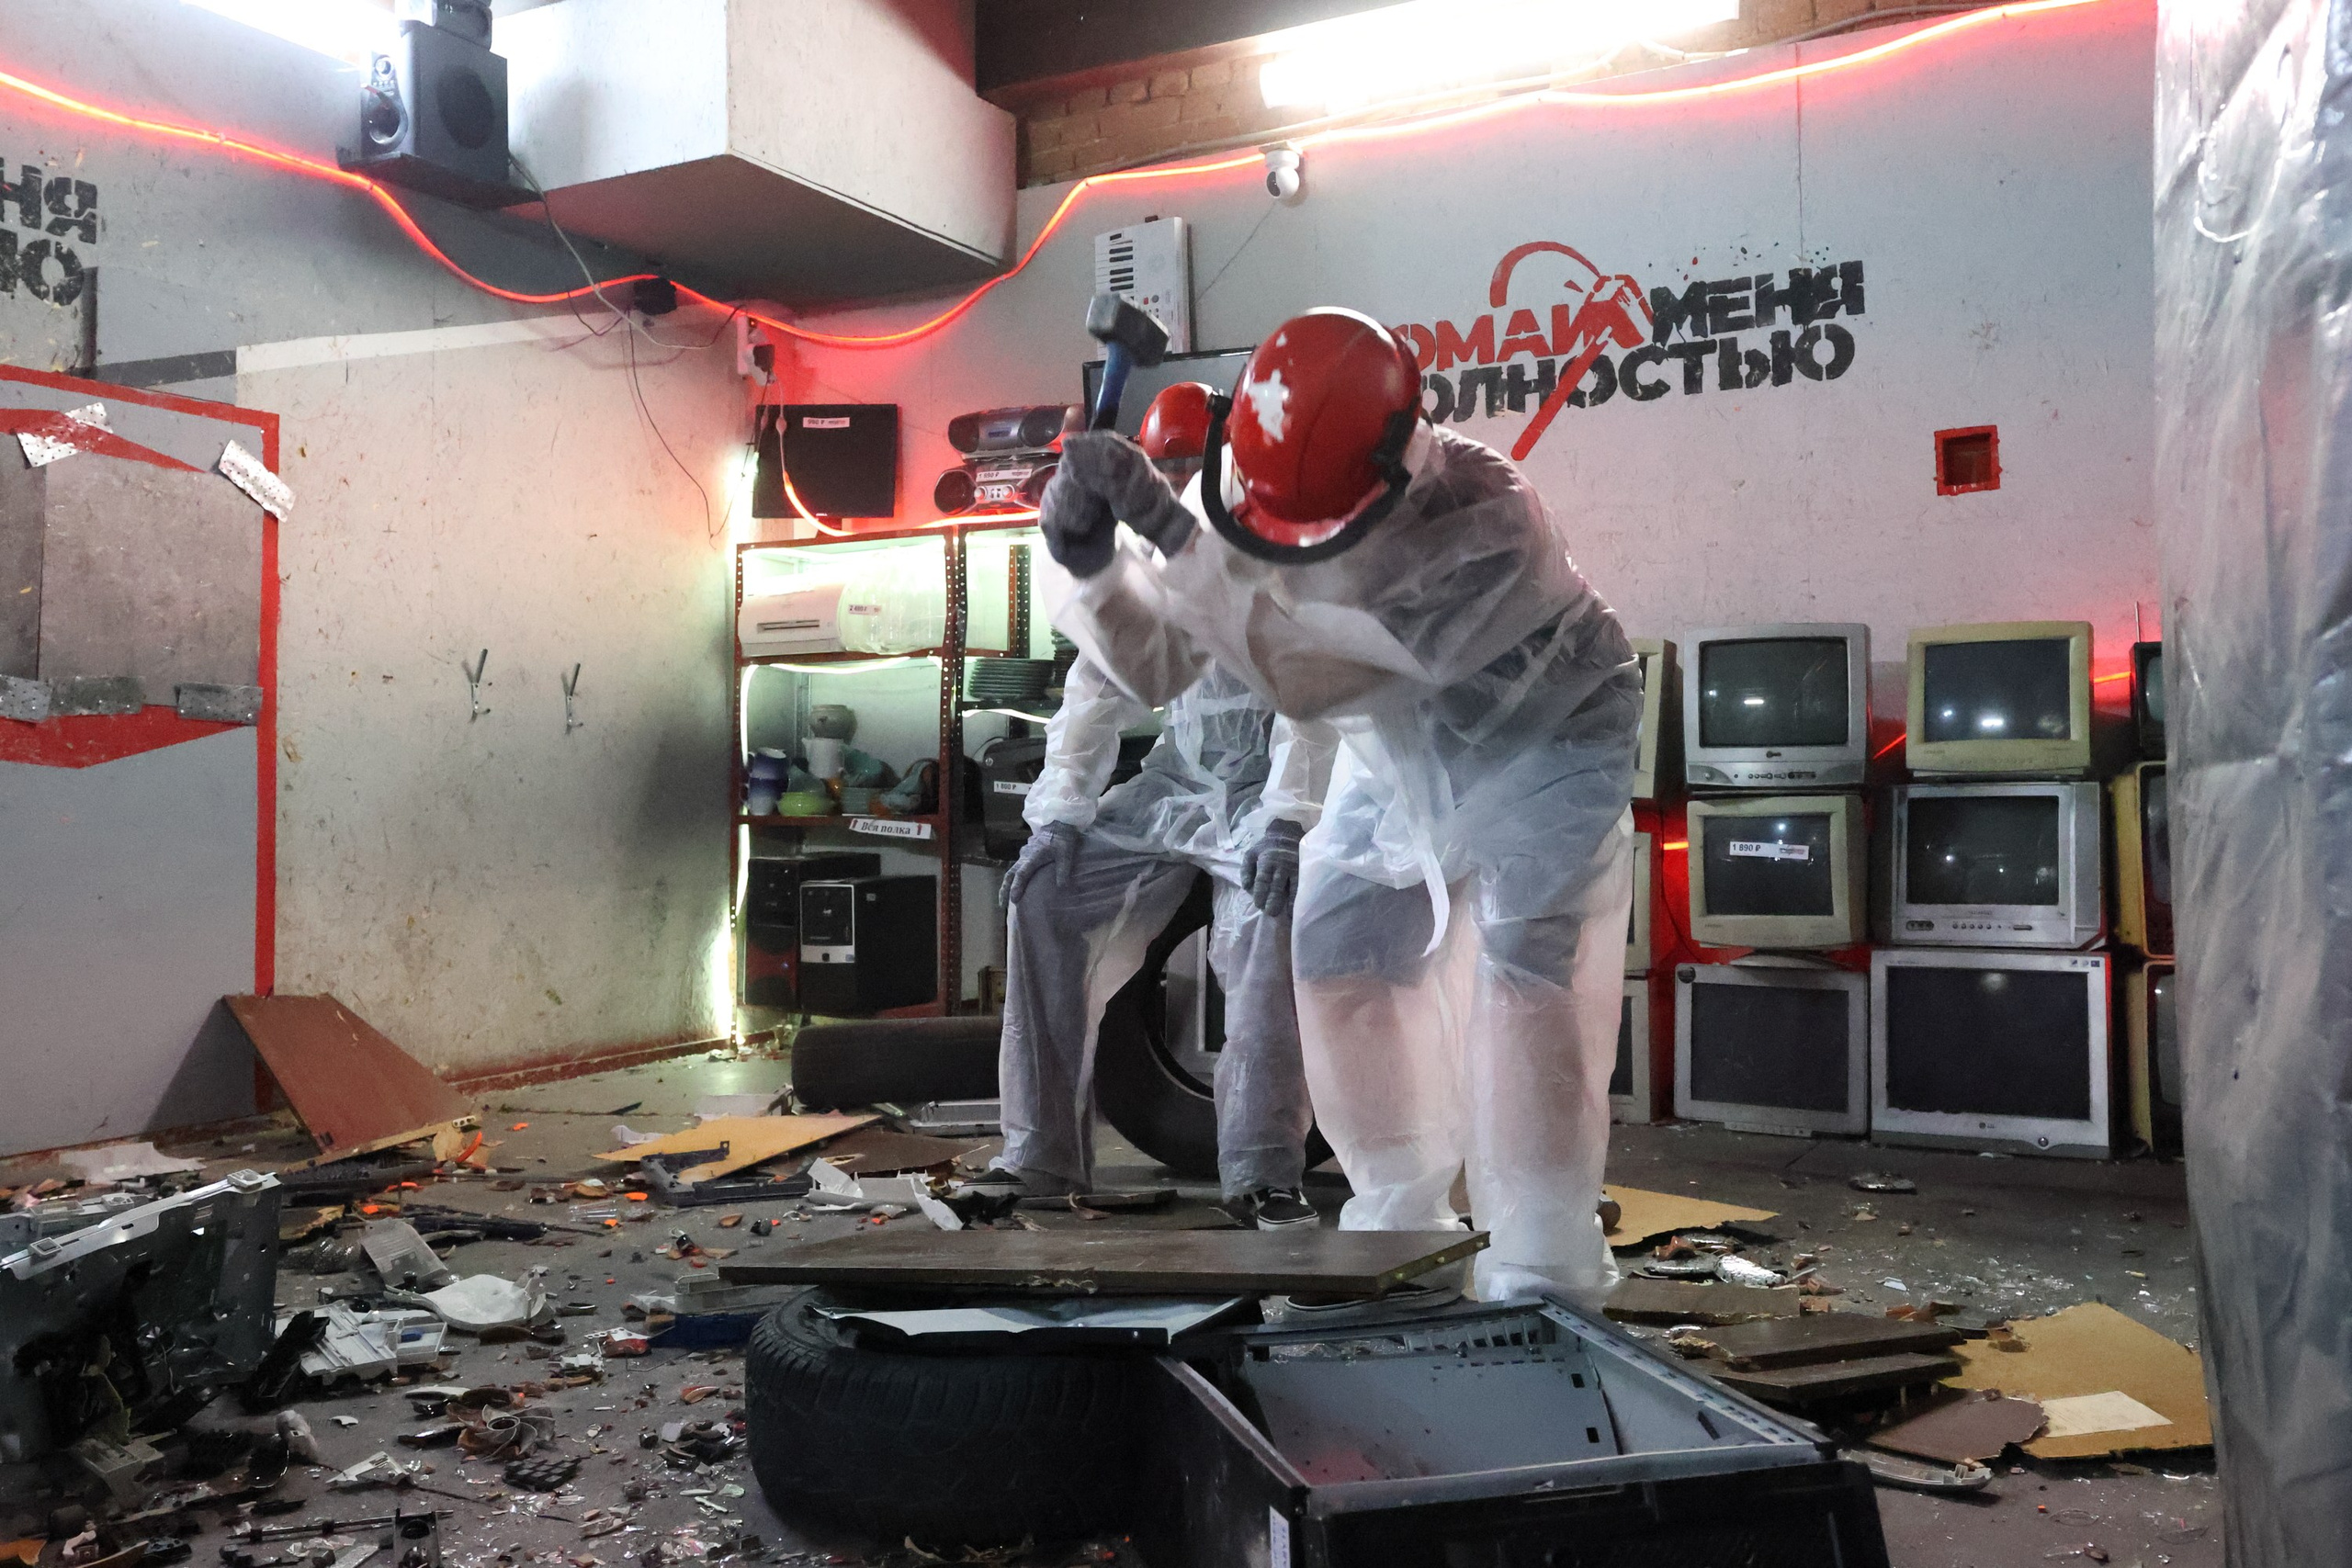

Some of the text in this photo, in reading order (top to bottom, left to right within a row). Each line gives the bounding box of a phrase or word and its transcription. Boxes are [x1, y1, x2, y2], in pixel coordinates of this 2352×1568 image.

[1650, 260, 1865, 345] МЕНЯ
[1421, 324, 1855, 424] ОЛНОСТЬЮ
[861, 821, 911, 835] Вся полка
[1738, 843, 1754, 852] 890
